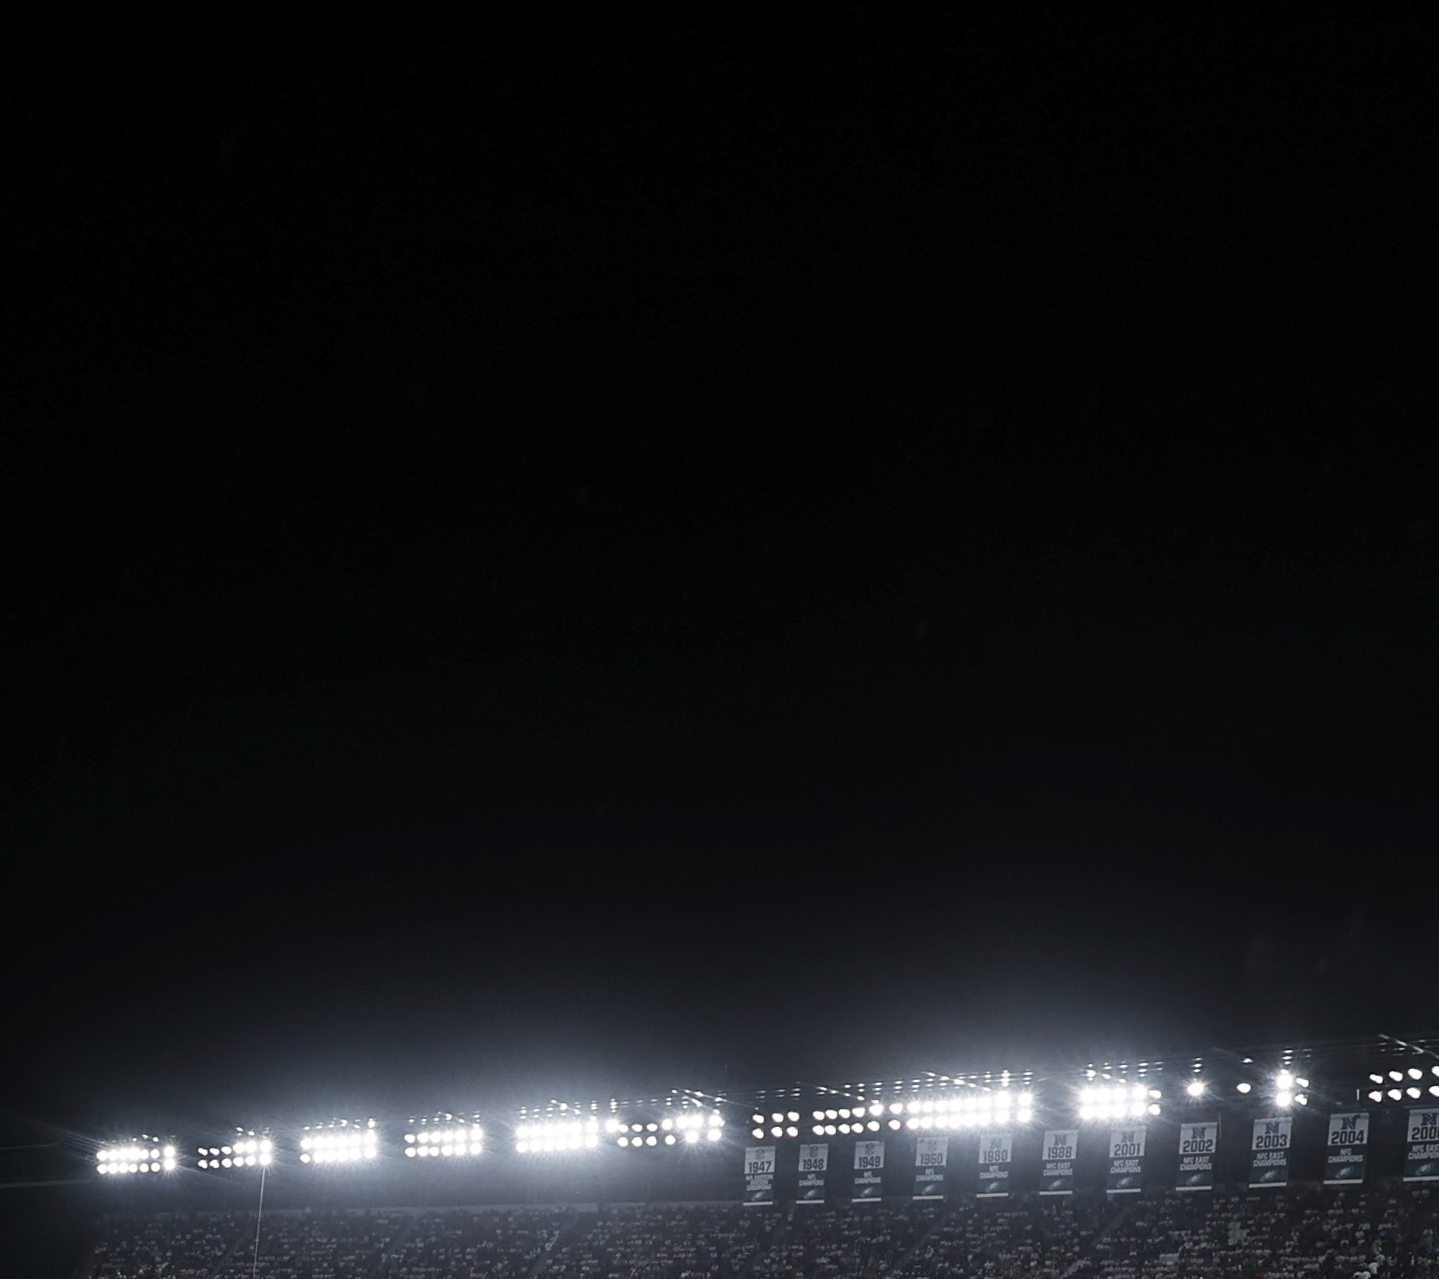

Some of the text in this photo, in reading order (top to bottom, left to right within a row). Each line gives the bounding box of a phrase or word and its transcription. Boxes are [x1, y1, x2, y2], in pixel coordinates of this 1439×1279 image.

[1255, 1134, 1288, 1148] 2003
[1330, 1130, 1365, 1145] 2004
[1113, 1143, 1142, 1157] 2001
[1182, 1139, 1214, 1153] 2002
